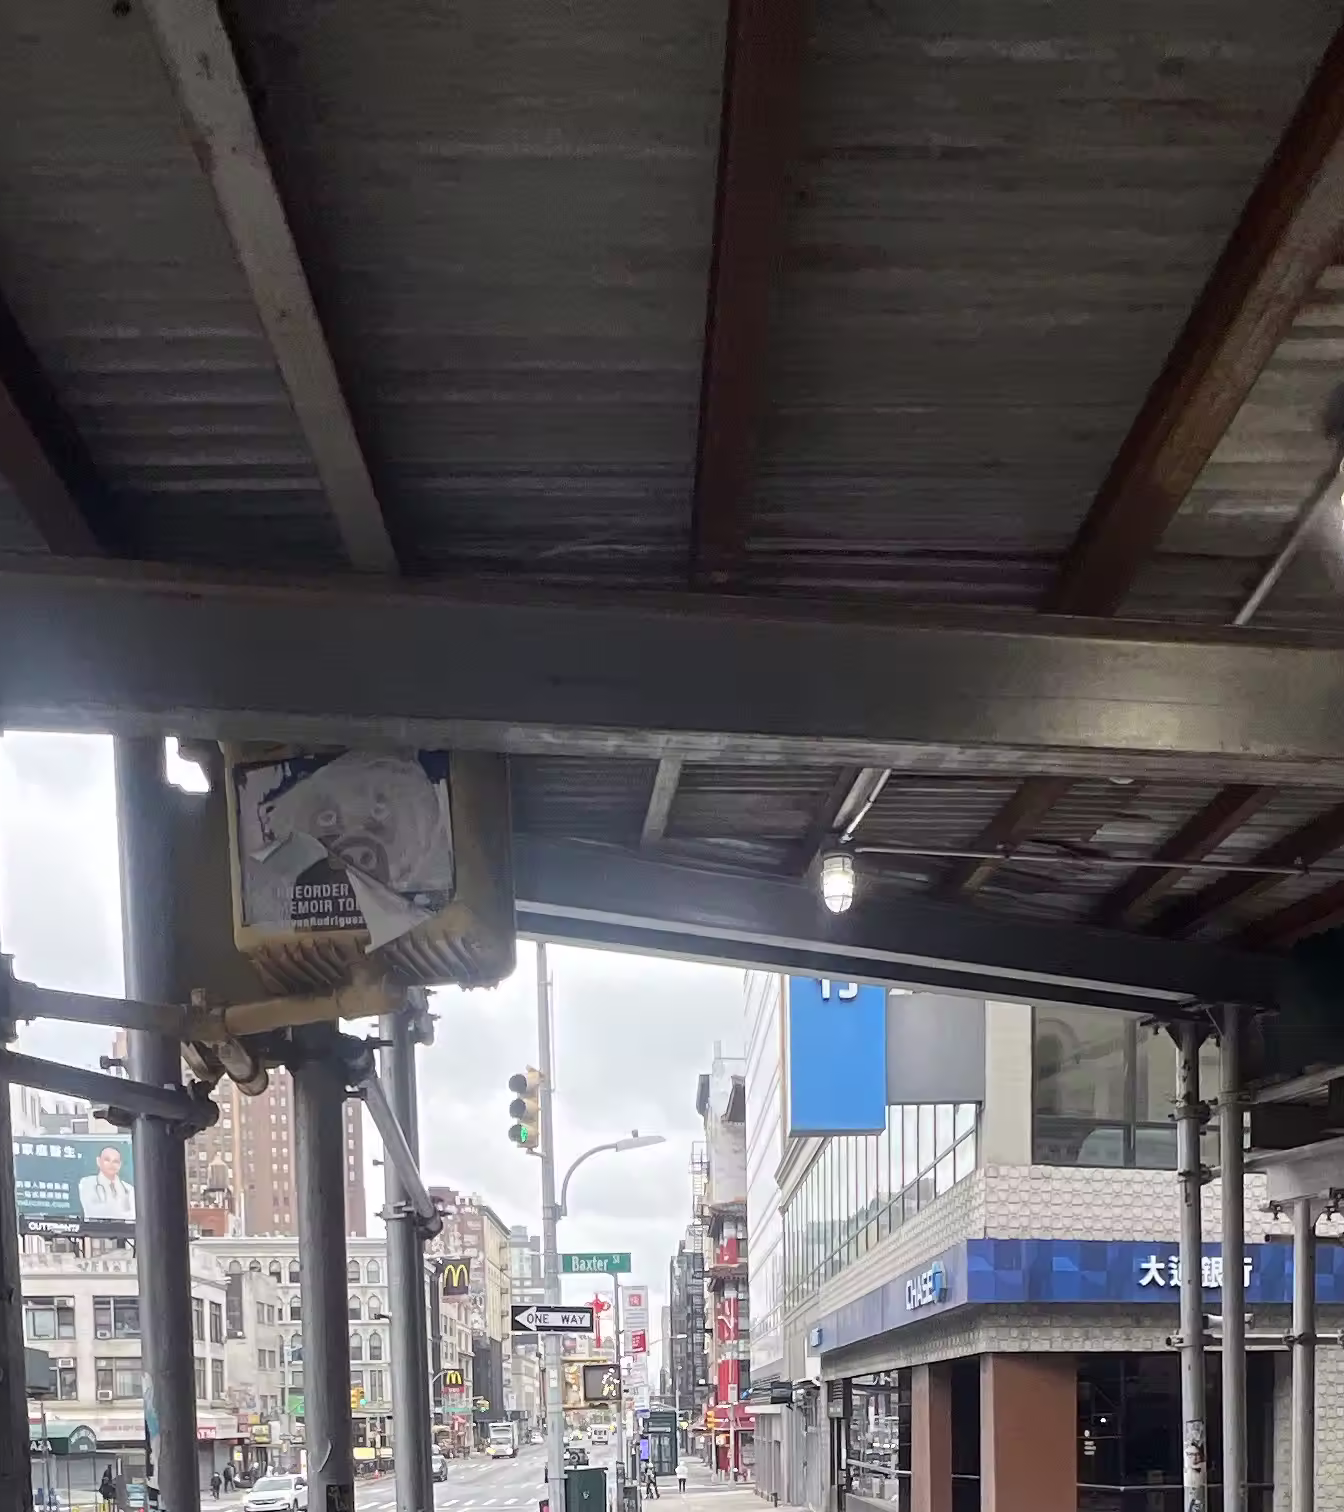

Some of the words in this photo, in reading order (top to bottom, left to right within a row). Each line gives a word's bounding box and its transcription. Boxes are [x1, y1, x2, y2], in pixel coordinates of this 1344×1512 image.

[280, 899, 333, 915] EMOIR
[338, 897, 360, 912] TO
[571, 1255, 609, 1272] Baxter
[905, 1269, 934, 1311] CHASE
[526, 1313, 550, 1325] ONE
[560, 1313, 586, 1325] WAY
